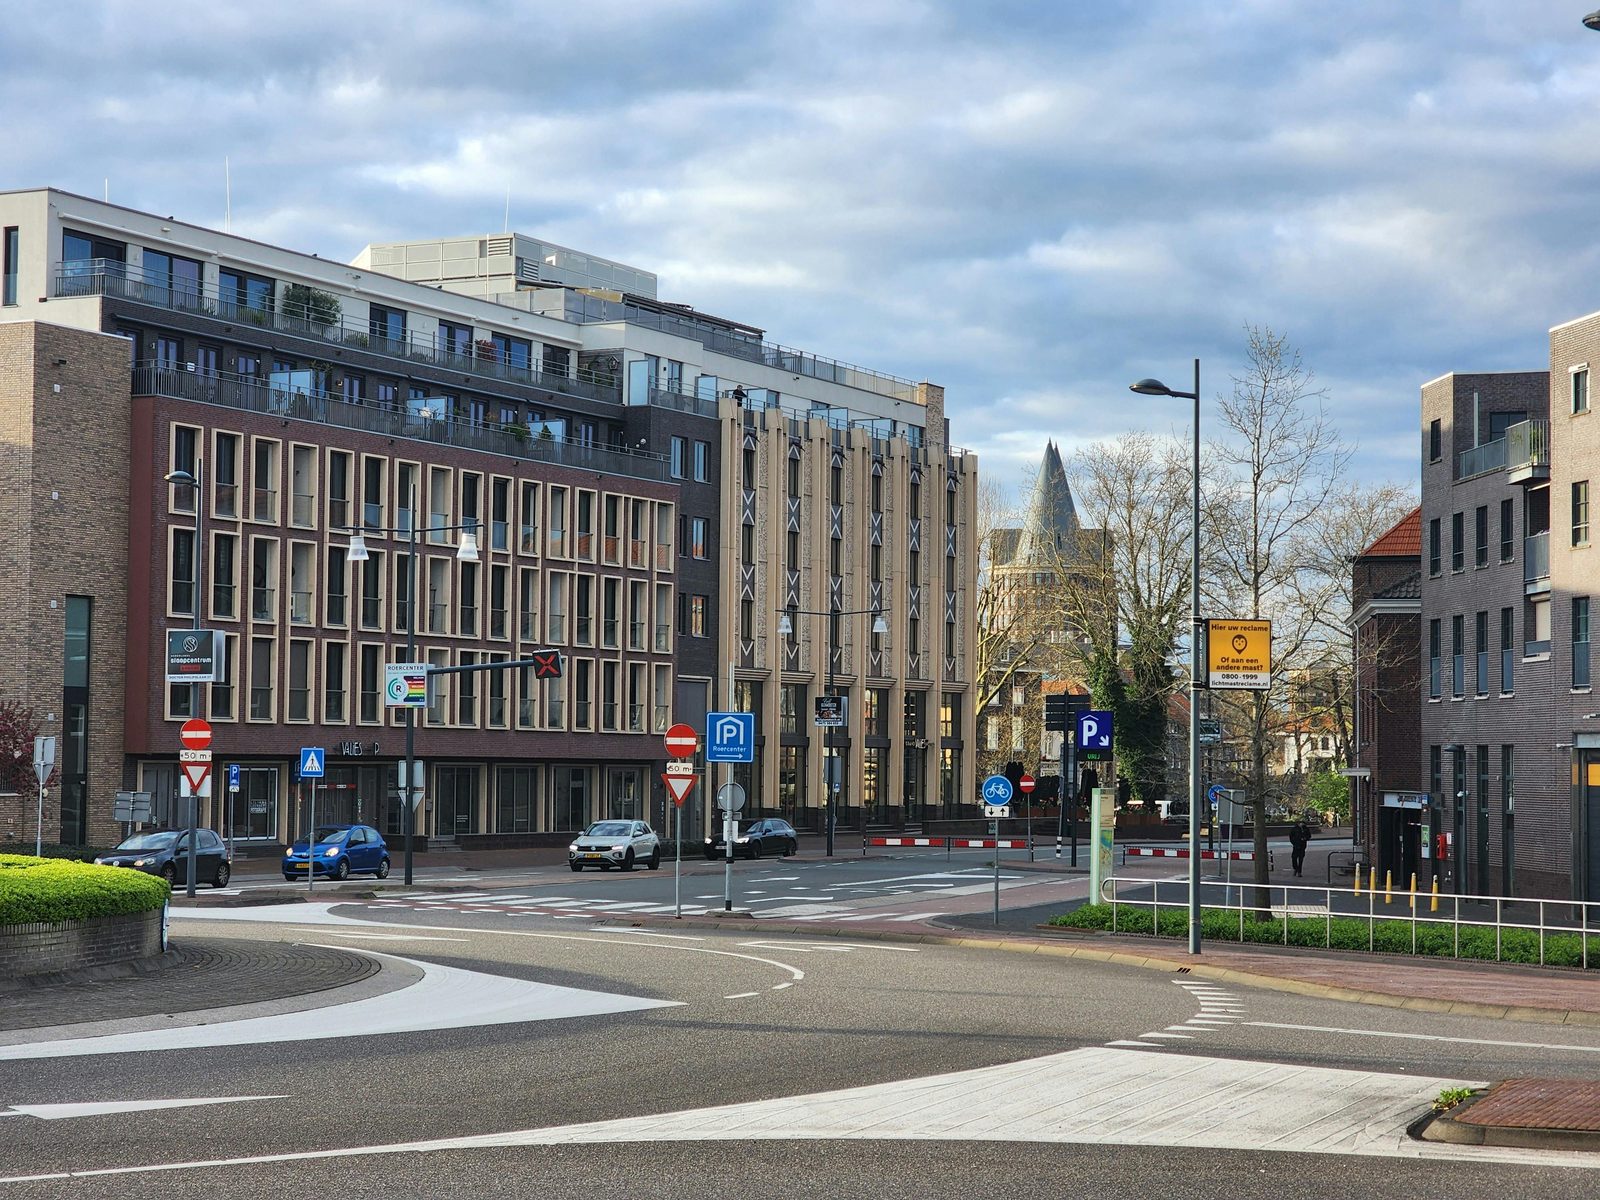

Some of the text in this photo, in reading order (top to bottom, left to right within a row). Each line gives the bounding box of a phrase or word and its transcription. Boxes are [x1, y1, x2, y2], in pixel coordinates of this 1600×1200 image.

[723, 724, 737, 745] P
[1083, 720, 1098, 746] P
[232, 766, 238, 778] P
